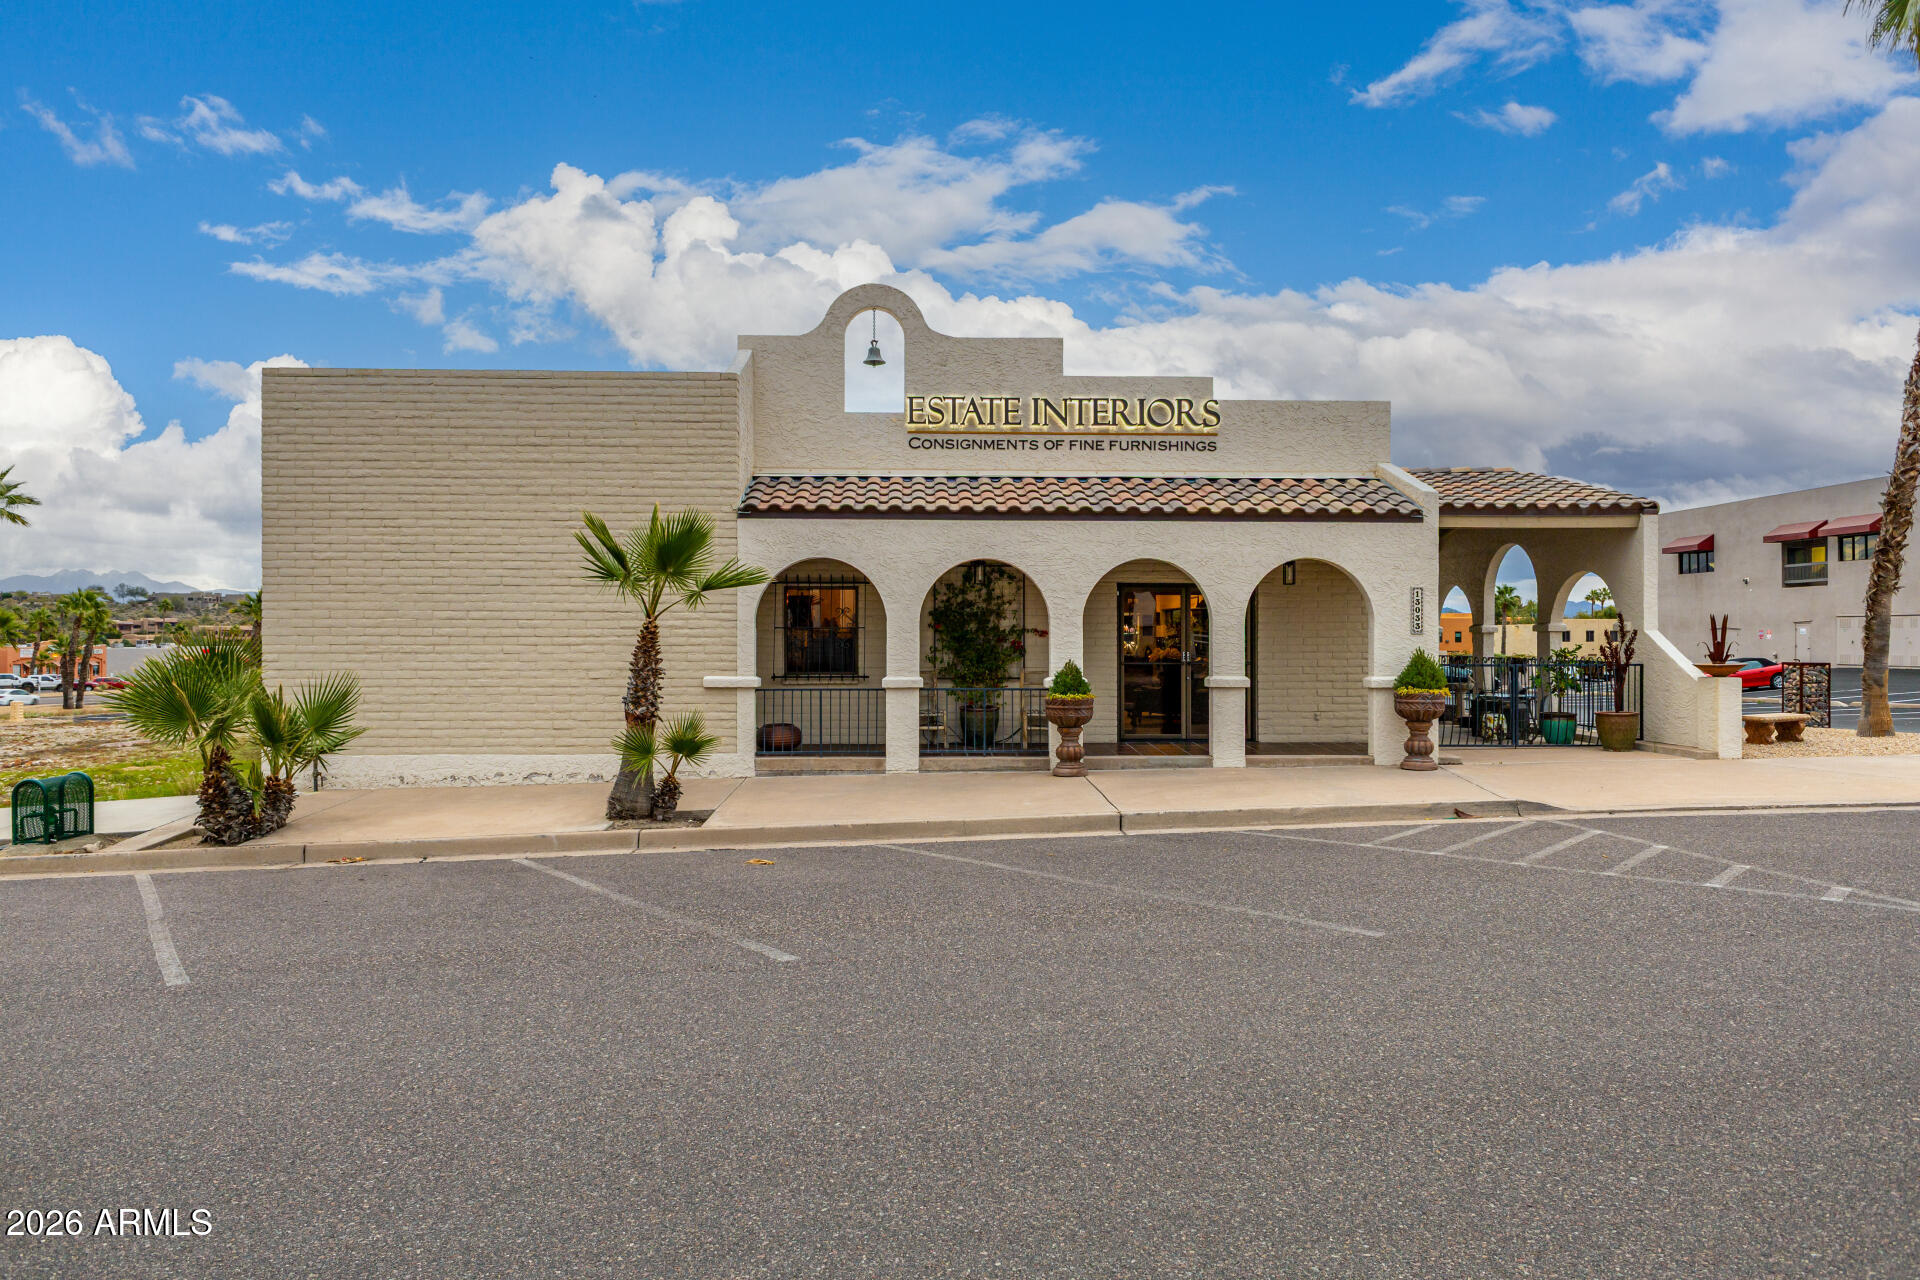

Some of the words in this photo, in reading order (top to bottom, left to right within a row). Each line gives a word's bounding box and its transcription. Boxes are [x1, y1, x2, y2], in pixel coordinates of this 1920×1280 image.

[907, 396, 1022, 425] ESTATE
[1031, 397, 1221, 427] INTERIORS
[908, 437, 1039, 450] CONSIGNMENTS
[1043, 439, 1065, 450] OF
[1069, 440, 1105, 451] FINE
[1109, 440, 1218, 452] FURNISHINGS
